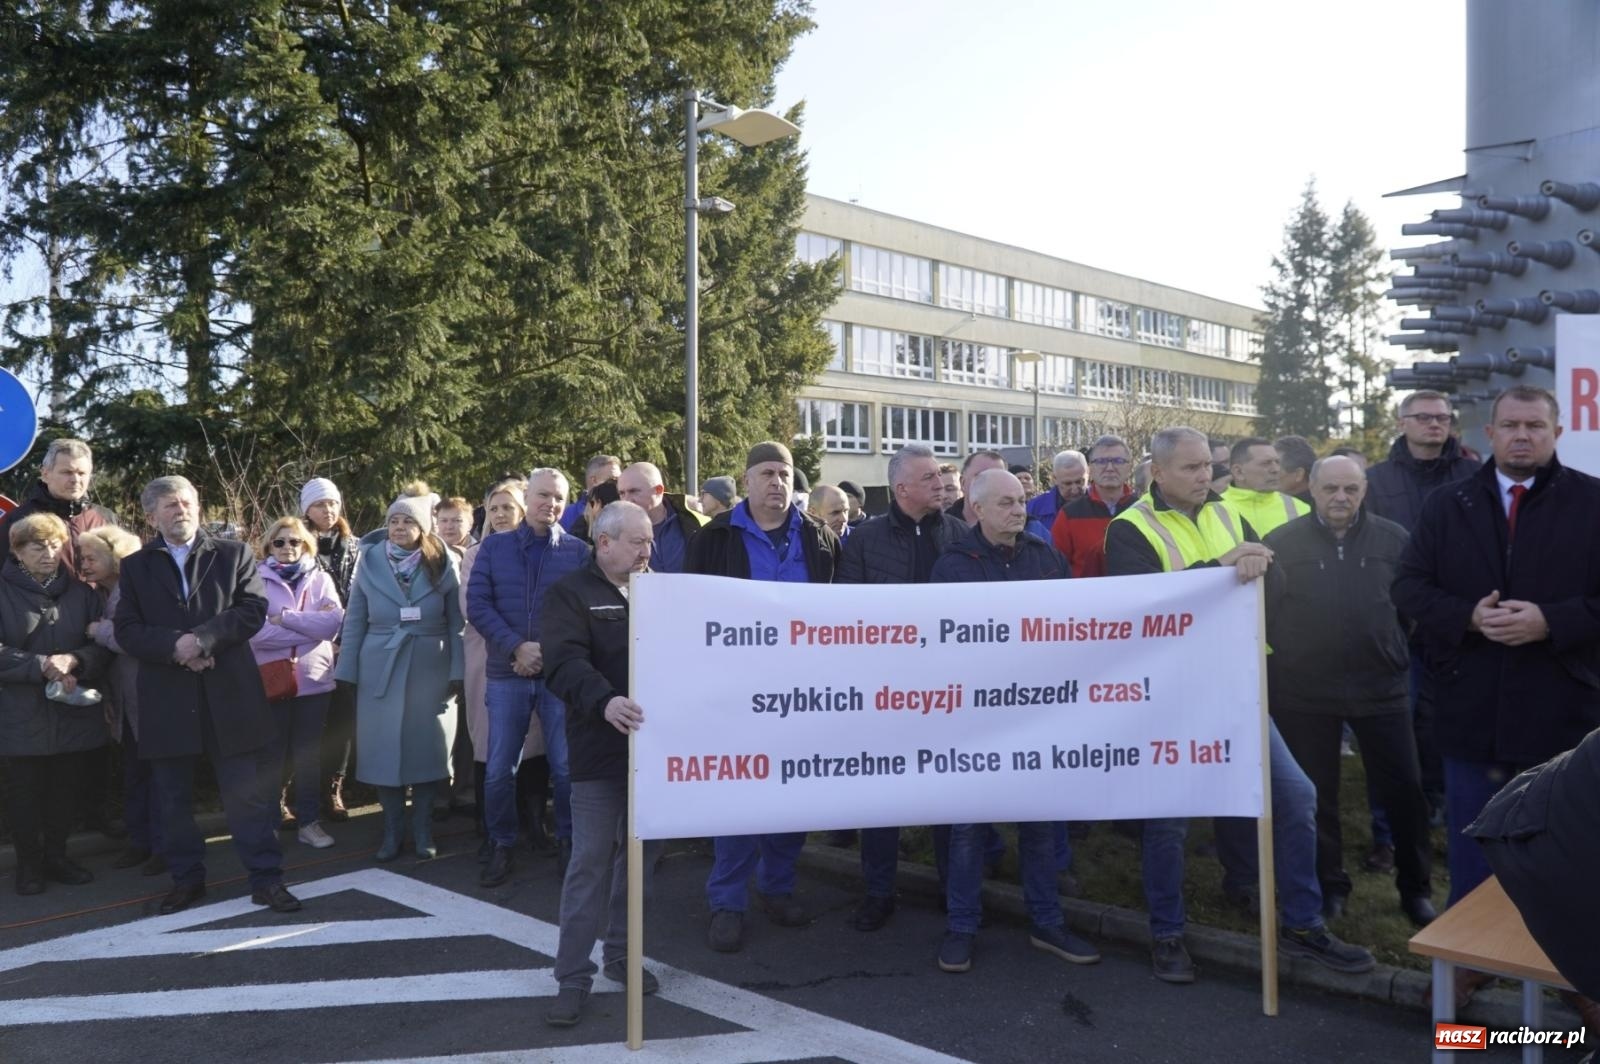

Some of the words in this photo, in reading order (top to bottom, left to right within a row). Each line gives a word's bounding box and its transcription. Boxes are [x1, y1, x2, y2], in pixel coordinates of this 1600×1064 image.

[705, 621, 779, 647] Panie
[790, 620, 927, 648] Premierze,
[939, 617, 1010, 644] Panie
[1021, 617, 1133, 642] Ministrze
[1141, 612, 1194, 639] MAP
[751, 686, 864, 719] szybkich
[874, 683, 963, 716] decyzji
[973, 679, 1080, 708] nadszedł
[1088, 676, 1151, 704] czas!
[666, 753, 770, 783] RAFAKO
[780, 750, 906, 785] potrzebne
[917, 747, 1001, 774] Polsce
[1011, 750, 1042, 772] na
[1051, 743, 1141, 774] kolejne
[1150, 740, 1180, 766] 75
[1189, 738, 1232, 765] lat!
